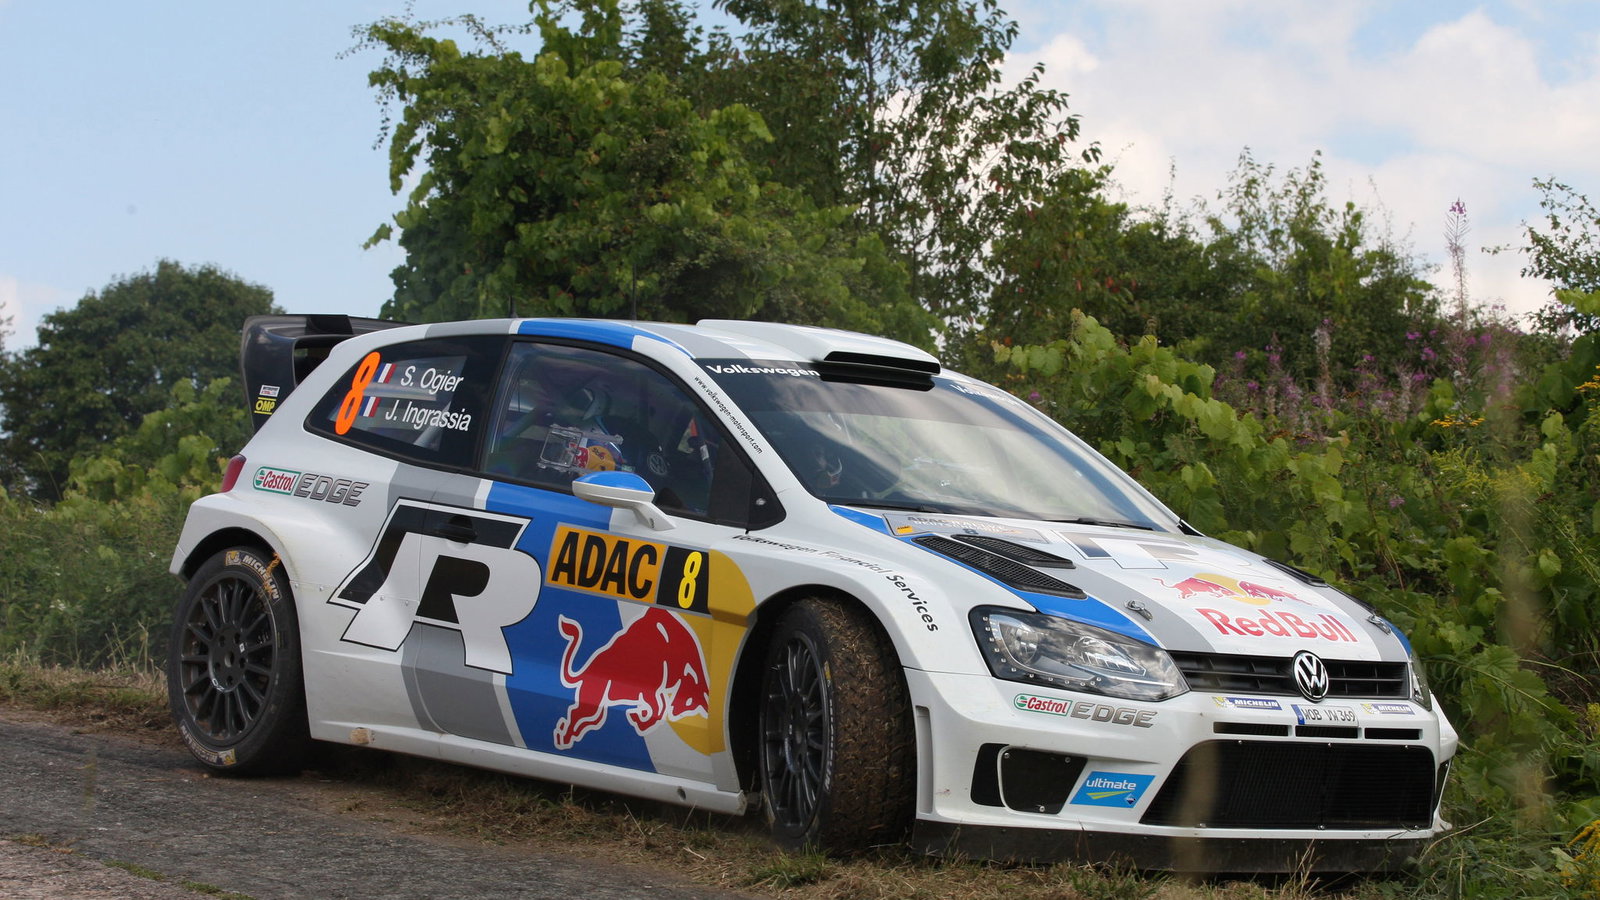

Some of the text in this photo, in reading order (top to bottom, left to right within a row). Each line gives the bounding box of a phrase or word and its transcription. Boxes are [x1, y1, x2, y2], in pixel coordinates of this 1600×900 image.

[400, 365, 464, 395] S. Ogier
[706, 364, 821, 377] Volkswagen
[255, 399, 276, 412] OMP
[335, 351, 381, 435] 8
[385, 399, 472, 432] J. Ingrassia
[694, 375, 763, 454] www.volkswagen-motorsport.com
[262, 470, 370, 507] Castrol EDGE
[551, 531, 702, 609] ADAC 8
[818, 550, 893, 574] Financial
[886, 574, 939, 632] Services
[1026, 697, 1158, 728] Castrol EDGE
[1233, 698, 1279, 708] MICHELIN
[1301, 708, 1323, 720] WOB
[1376, 704, 1411, 713] MICHELIN
[1086, 777, 1137, 791] ultimate
